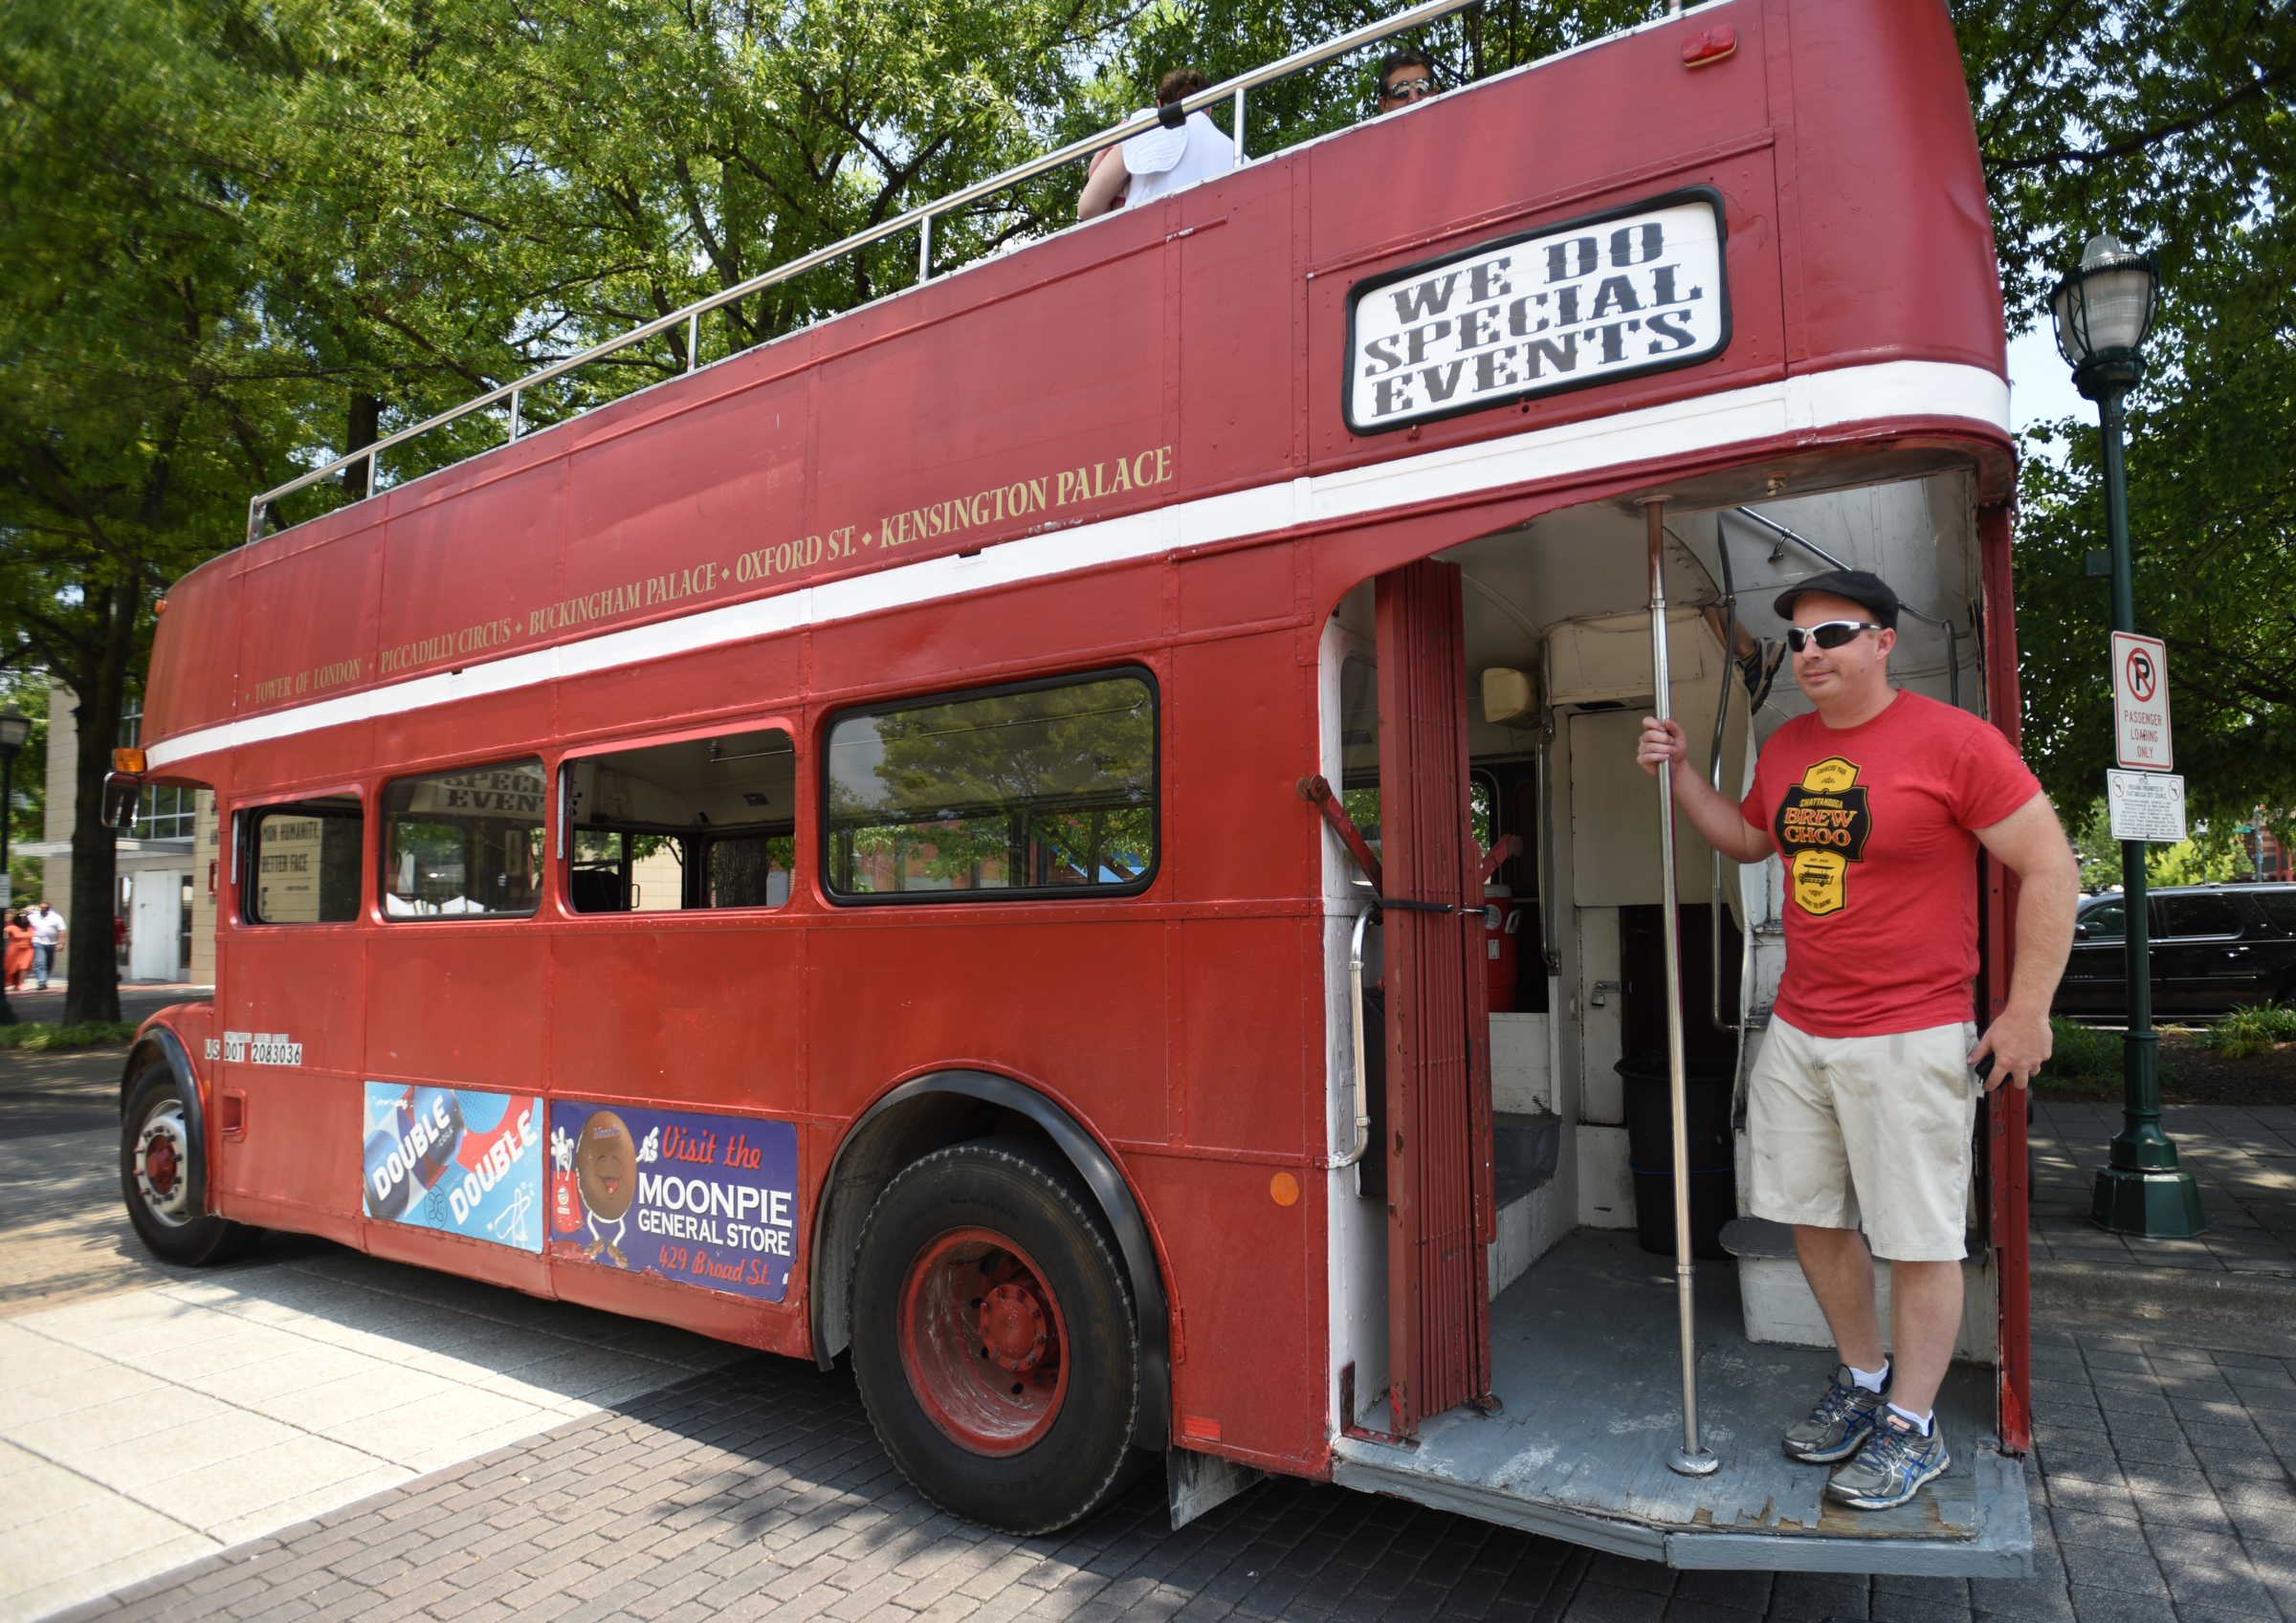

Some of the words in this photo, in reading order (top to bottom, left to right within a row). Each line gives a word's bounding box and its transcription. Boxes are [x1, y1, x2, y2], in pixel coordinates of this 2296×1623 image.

[1388, 256, 1512, 325] WE
[1542, 222, 1665, 285] DO
[1364, 263, 1704, 378] SPECIAL
[1371, 308, 1697, 418] EVENTS
[254, 676, 292, 704] TOWER
[295, 670, 310, 694] OF
[313, 658, 362, 690] LONDON
[380, 632, 456, 674] PICCADILLY
[457, 617, 512, 653] CIRCUS
[528, 581, 642, 636] BUCKINGHAM
[645, 561, 718, 606] PALACE
[736, 535, 823, 583] OXFORD
[828, 525, 857, 561] ST.
[878, 476, 1049, 549] KENSINGTON
[1055, 445, 1173, 507] PALACE
[2124, 710, 2162, 727] PASSENGER
[2130, 728, 2158, 743] LOADING
[2136, 745, 2153, 758] ONLY
[443, 772, 545, 794] SPECI
[447, 789, 545, 813] EVEN
[1799, 798, 1843, 809] CHATTANOOGA
[1784, 806, 1858, 828] BREW
[1783, 825, 1851, 846] CHOO
[260, 854, 287, 873] BETTER
[290, 853, 308, 872] FACE
[206, 1040, 219, 1058] US
[225, 1042, 244, 1061] DOT
[252, 1043, 300, 1064] 2083036
[372, 1095, 451, 1201] DOUBLE
[438, 1127, 453, 1147] COLA
[662, 1126, 717, 1164] Visit
[723, 1134, 762, 1170] the
[449, 1109, 538, 1226] DOUBLE
[638, 1172, 792, 1228] MOONPIE
[638, 1208, 724, 1245] GENERAL
[726, 1223, 790, 1257] STORE
[659, 1244, 688, 1270] 429
[692, 1250, 746, 1283] Broad
[746, 1258, 771, 1286] St.
